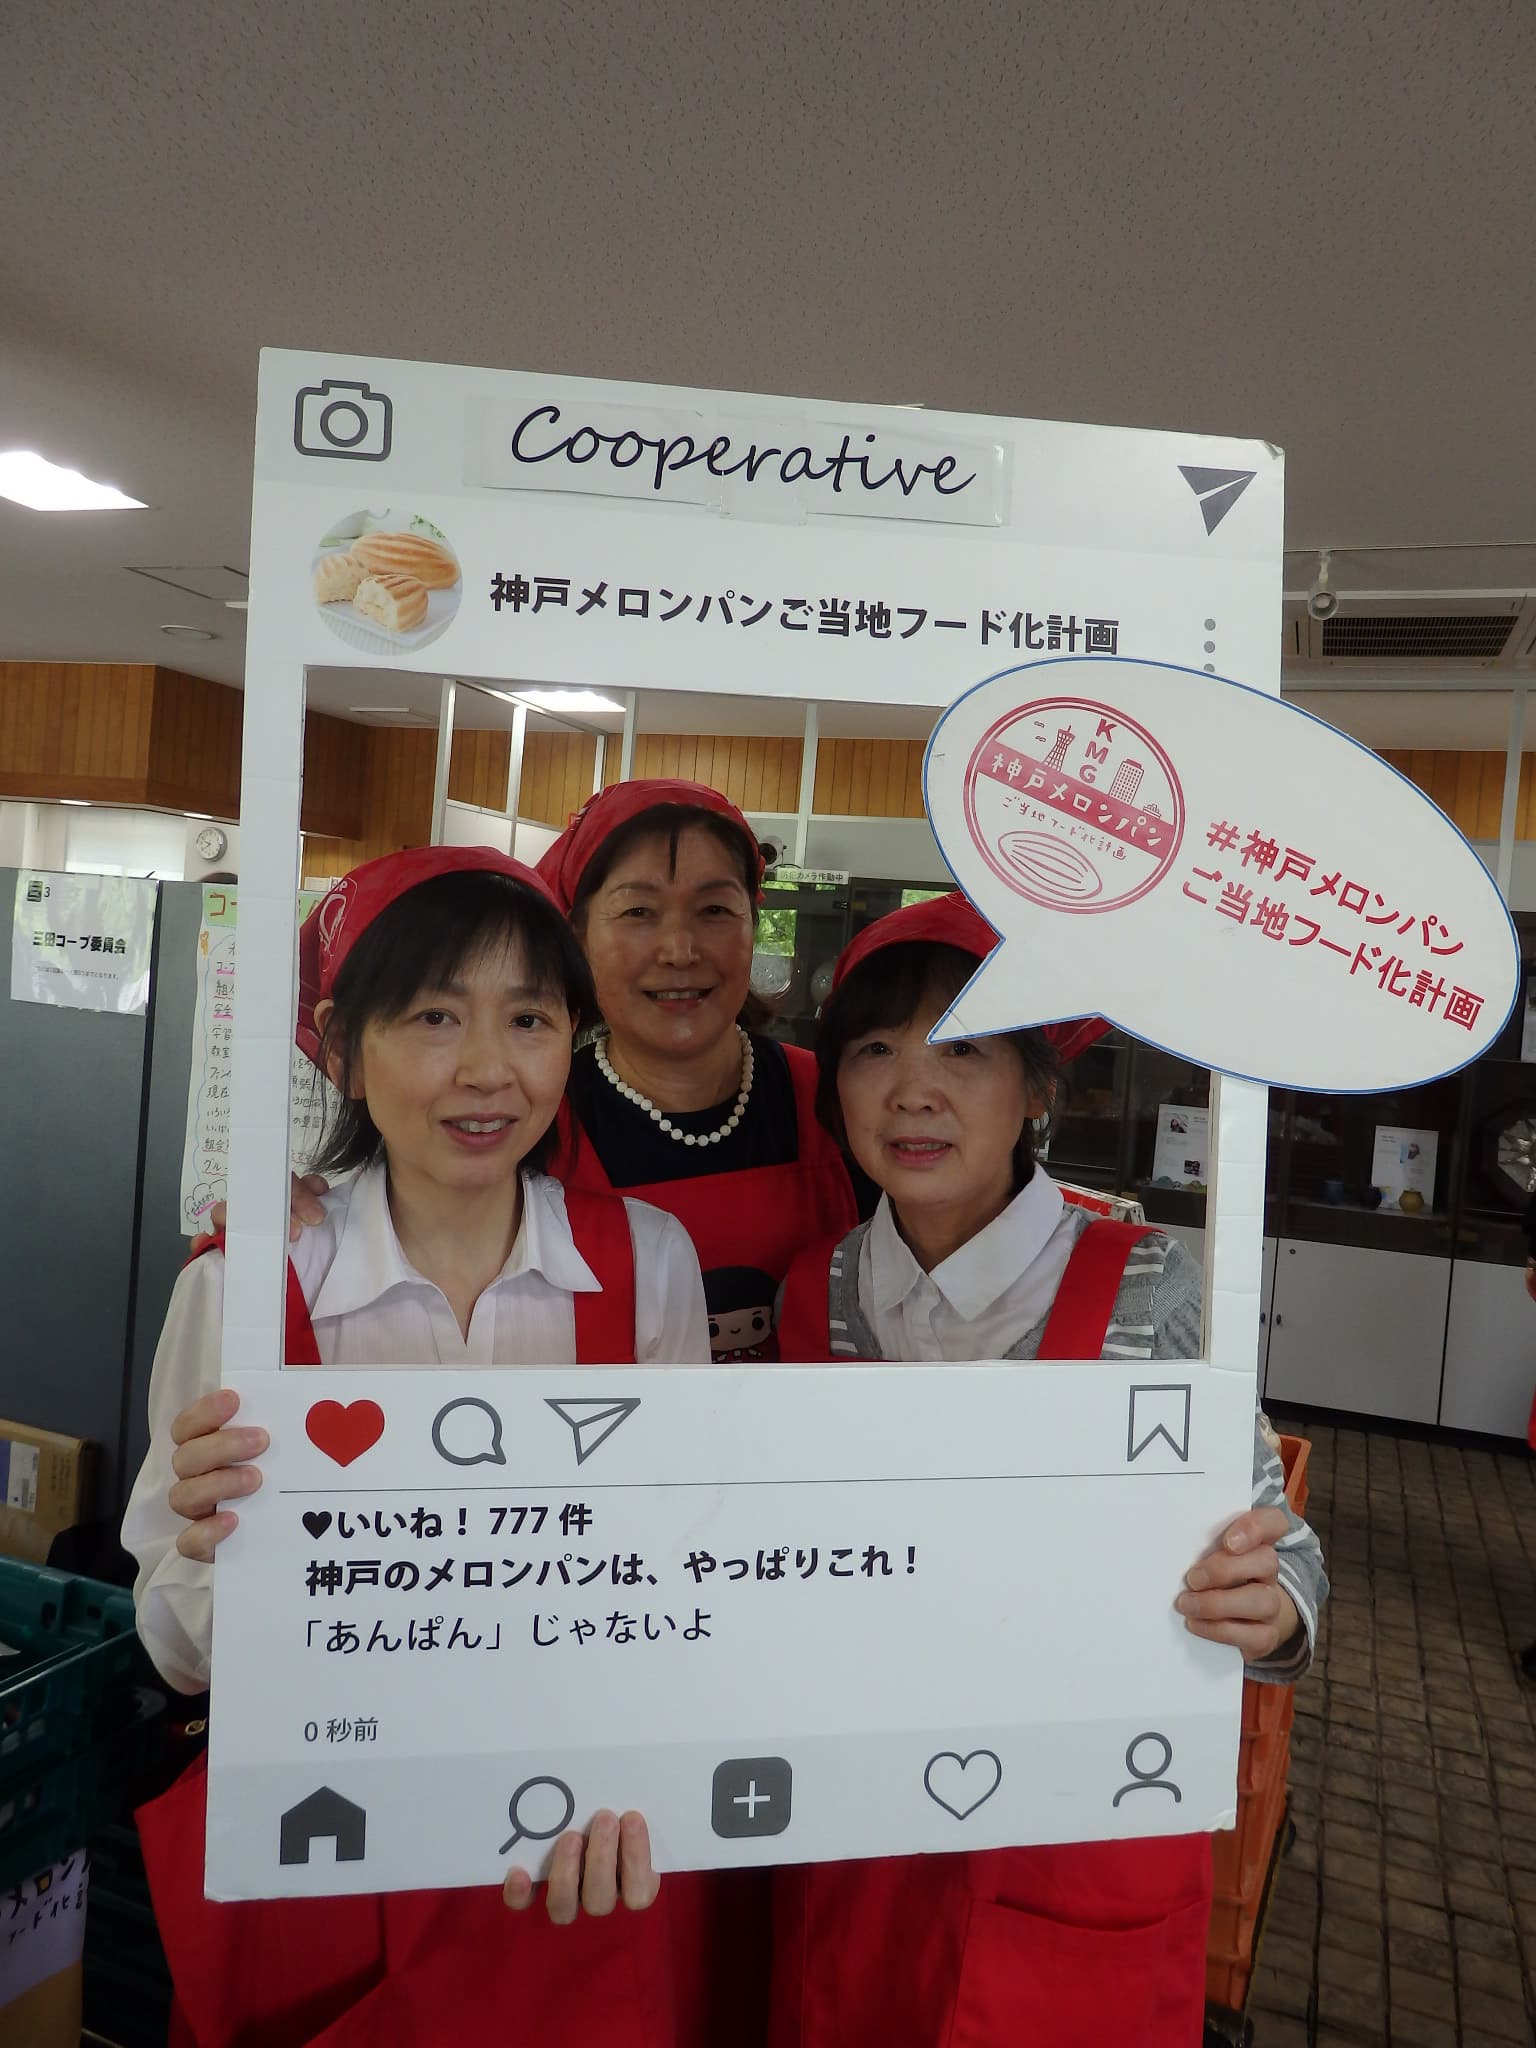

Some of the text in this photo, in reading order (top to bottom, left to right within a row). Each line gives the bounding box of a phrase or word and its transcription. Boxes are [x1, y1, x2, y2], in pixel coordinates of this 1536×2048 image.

[511, 405, 976, 495] Cooperative
[490, 572, 1119, 654] 神戸メロンパンご当地フード化計画
[991, 753, 1162, 847] 神戸メロンパン
[1003, 796, 1127, 860] ご当地フード化計画
[32, 930, 127, 954] 三田コープ委員会
[1183, 867, 1485, 1031] ご当地フード化計画
[490, 1506, 549, 1536] 777
[559, 1503, 593, 1537] 件
